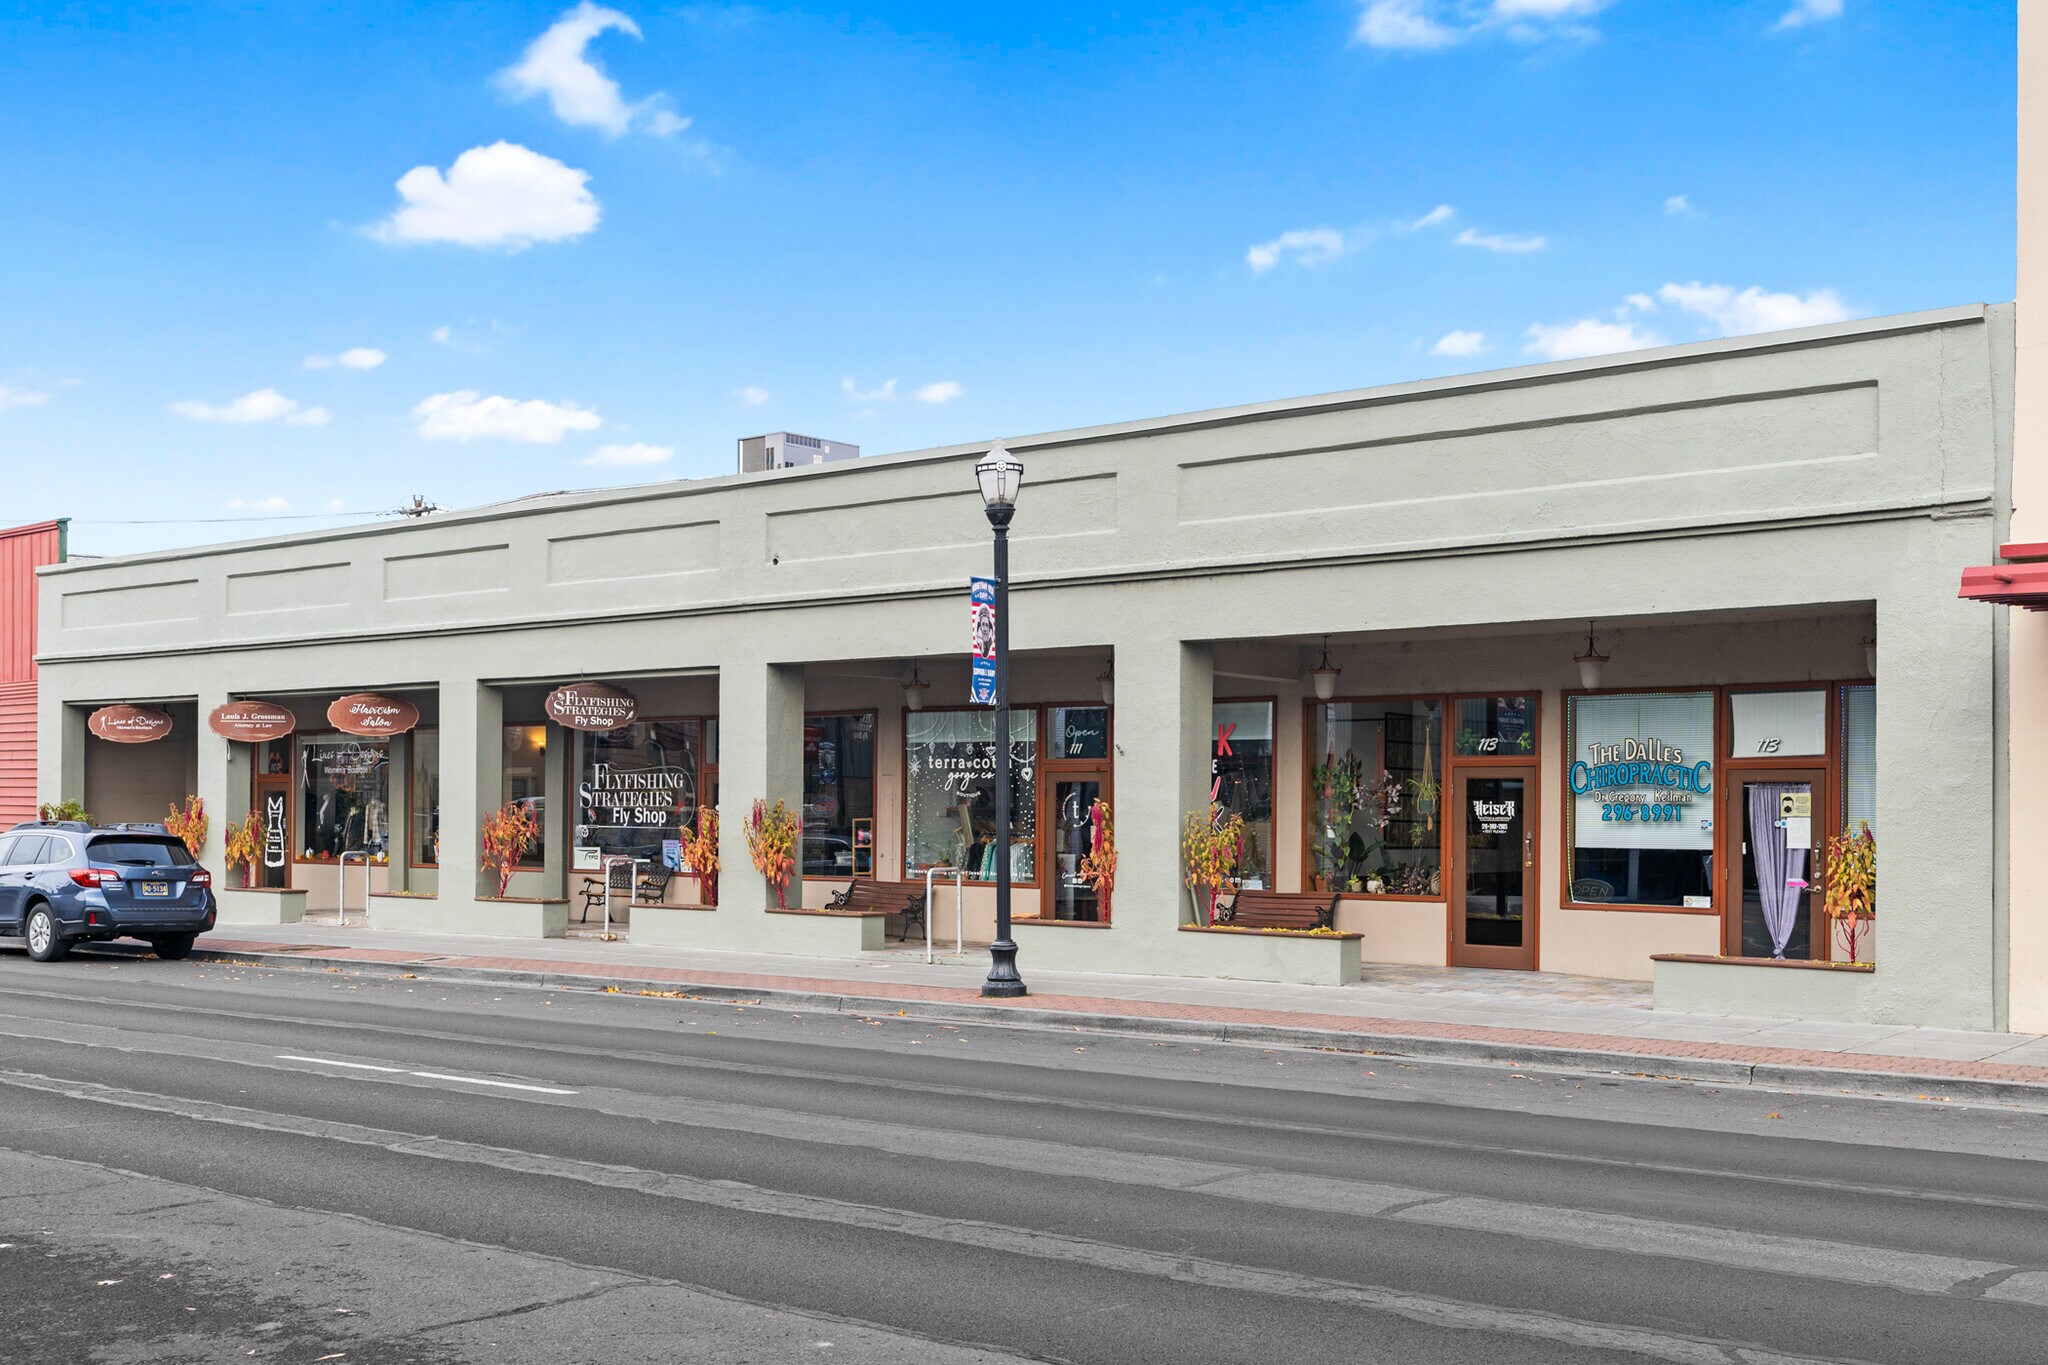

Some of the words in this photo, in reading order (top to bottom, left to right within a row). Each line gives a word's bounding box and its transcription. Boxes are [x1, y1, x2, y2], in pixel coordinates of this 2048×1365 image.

[564, 690, 634, 707] FLYFISHING
[553, 700, 626, 716] STRATEGIES
[107, 716, 126, 726] Lines
[127, 716, 135, 728] of
[360, 716, 392, 727] Salon
[575, 716, 588, 727] Fly
[590, 716, 614, 727] Shop
[1065, 725, 1099, 744] Open
[1069, 743, 1083, 754] 111
[1478, 737, 1499, 751] 113
[1757, 738, 1780, 753] 113
[1589, 742, 1620, 765] THE
[928, 755, 965, 769] terra
[973, 755, 1013, 769] cot
[324, 766, 346, 774] Women's
[347, 765, 371, 775] Boutique
[592, 763, 684, 790] FLYFISHING
[944, 771, 979, 791] gorge
[1569, 761, 1711, 795] CHIROPRACTIC
[579, 782, 673, 808] STRATEGIES
[956, 790, 981, 798] BOUTIQUE
[1608, 791, 1647, 804] Gregory
[1654, 789, 1692, 803] Keilman
[613, 807, 630, 827] Fly
[634, 807, 667, 827] Shop
[1602, 804, 1682, 821] 296-8991
[1572, 886, 1610, 897] OPEN
